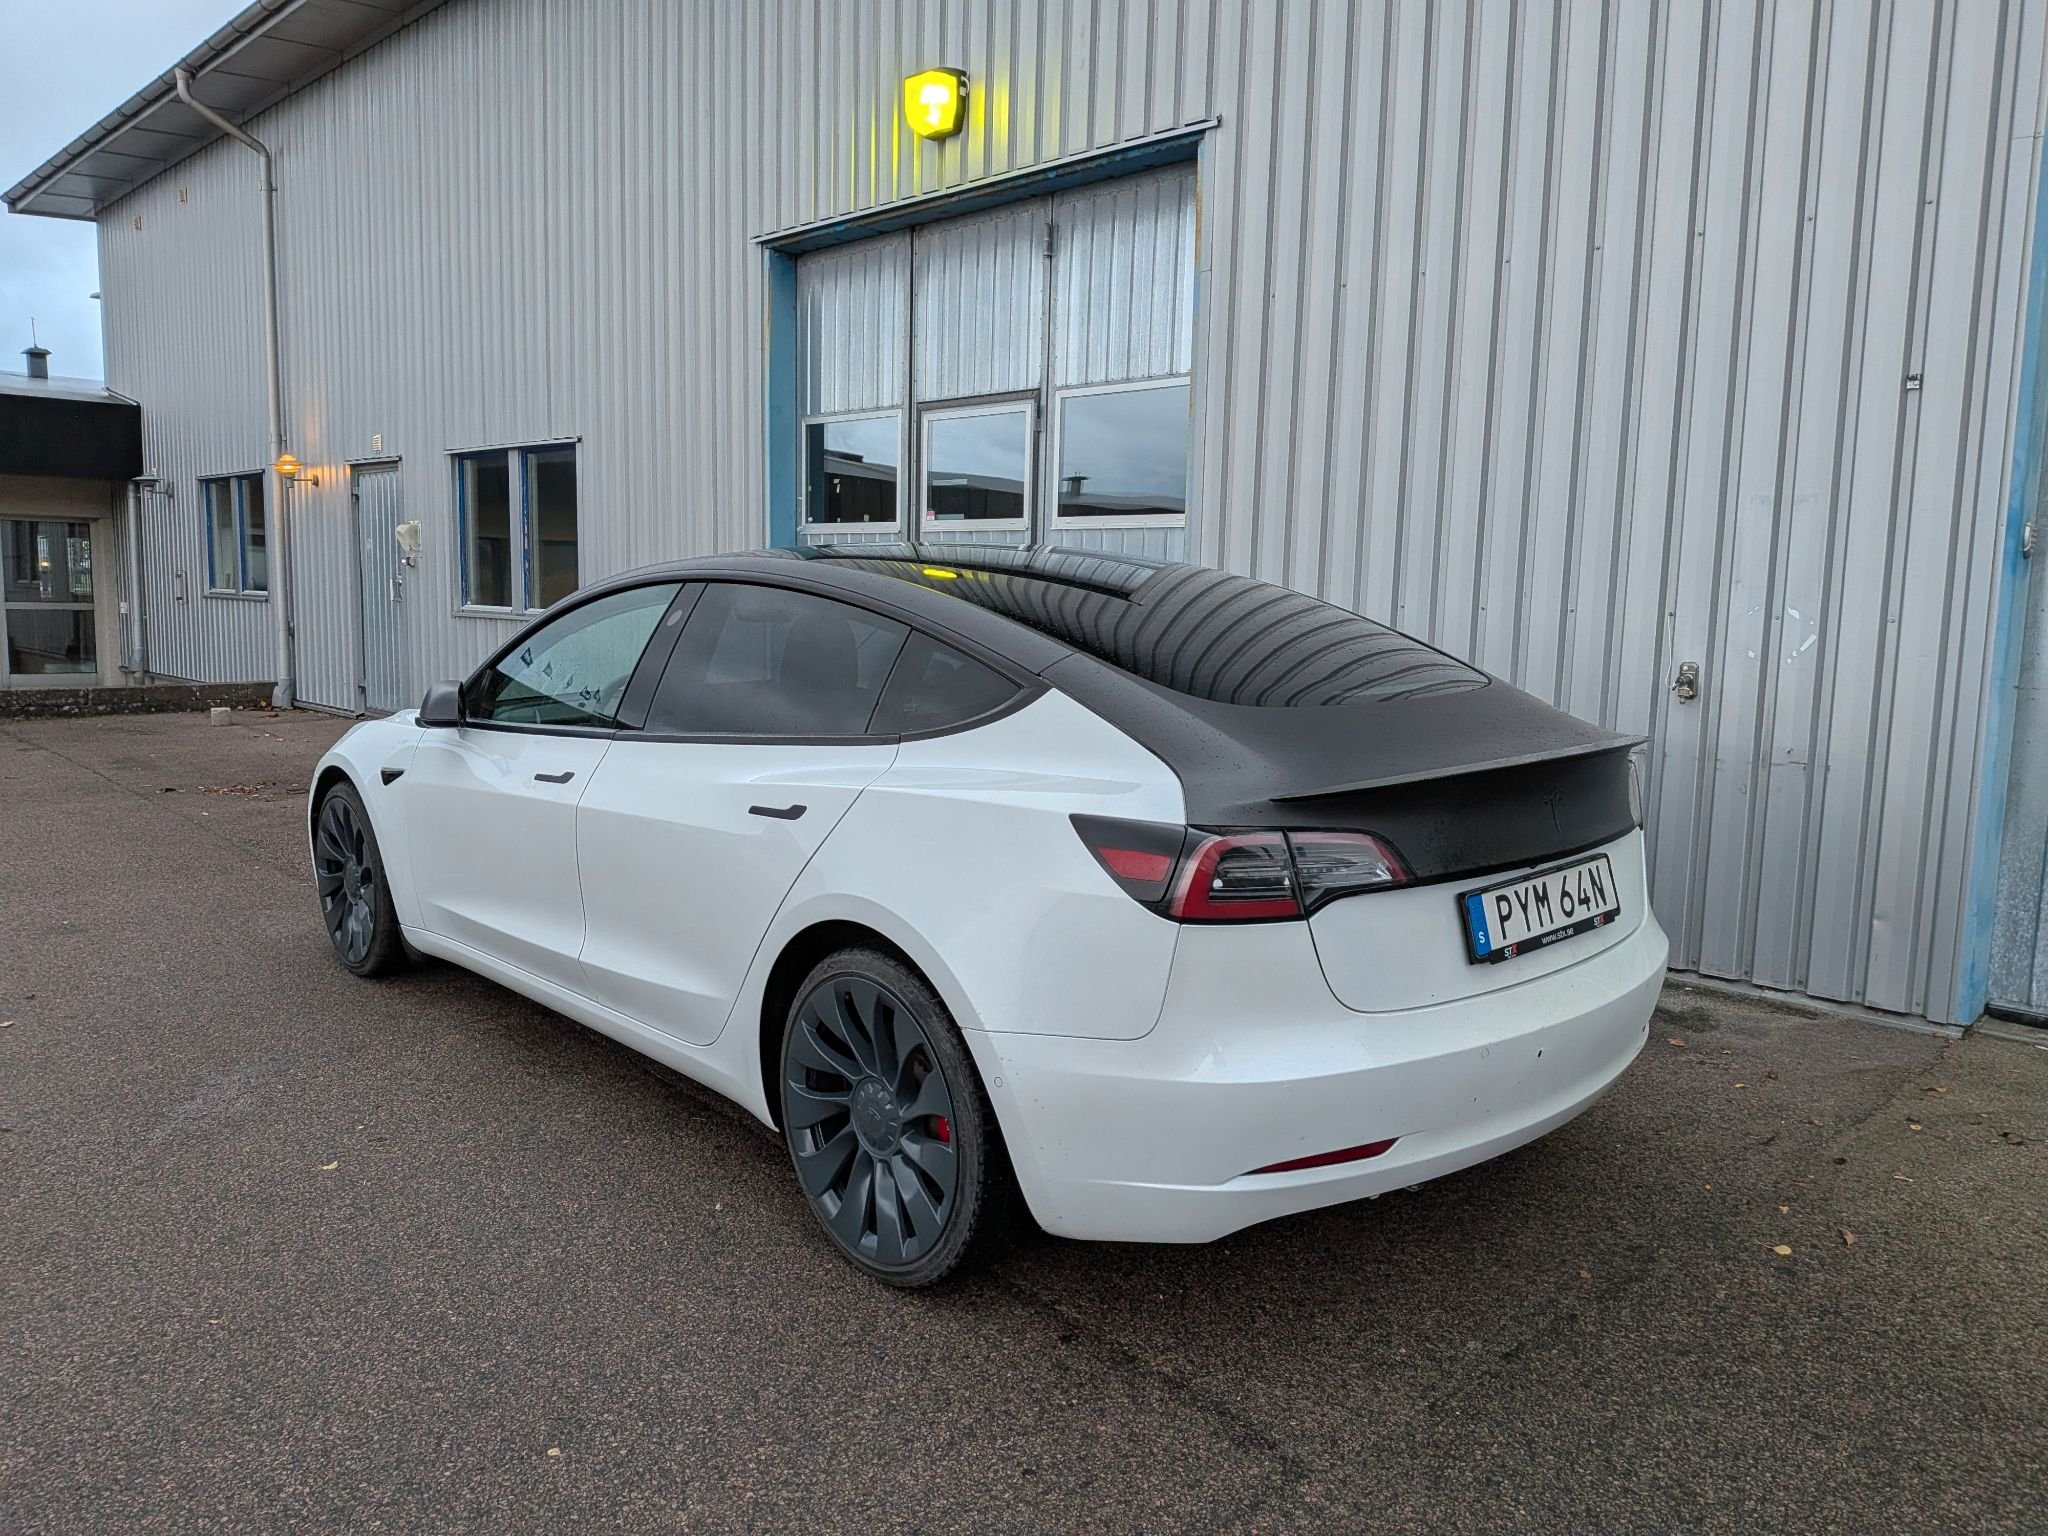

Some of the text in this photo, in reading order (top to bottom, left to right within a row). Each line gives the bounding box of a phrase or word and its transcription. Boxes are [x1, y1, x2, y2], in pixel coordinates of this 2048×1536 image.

[1495, 865, 1607, 940] PYM 64N
[1593, 912, 1605, 926] STX
[1478, 931, 1486, 944] S
[1541, 927, 1574, 945] www.stx.se
[1504, 943, 1519, 957] STX
